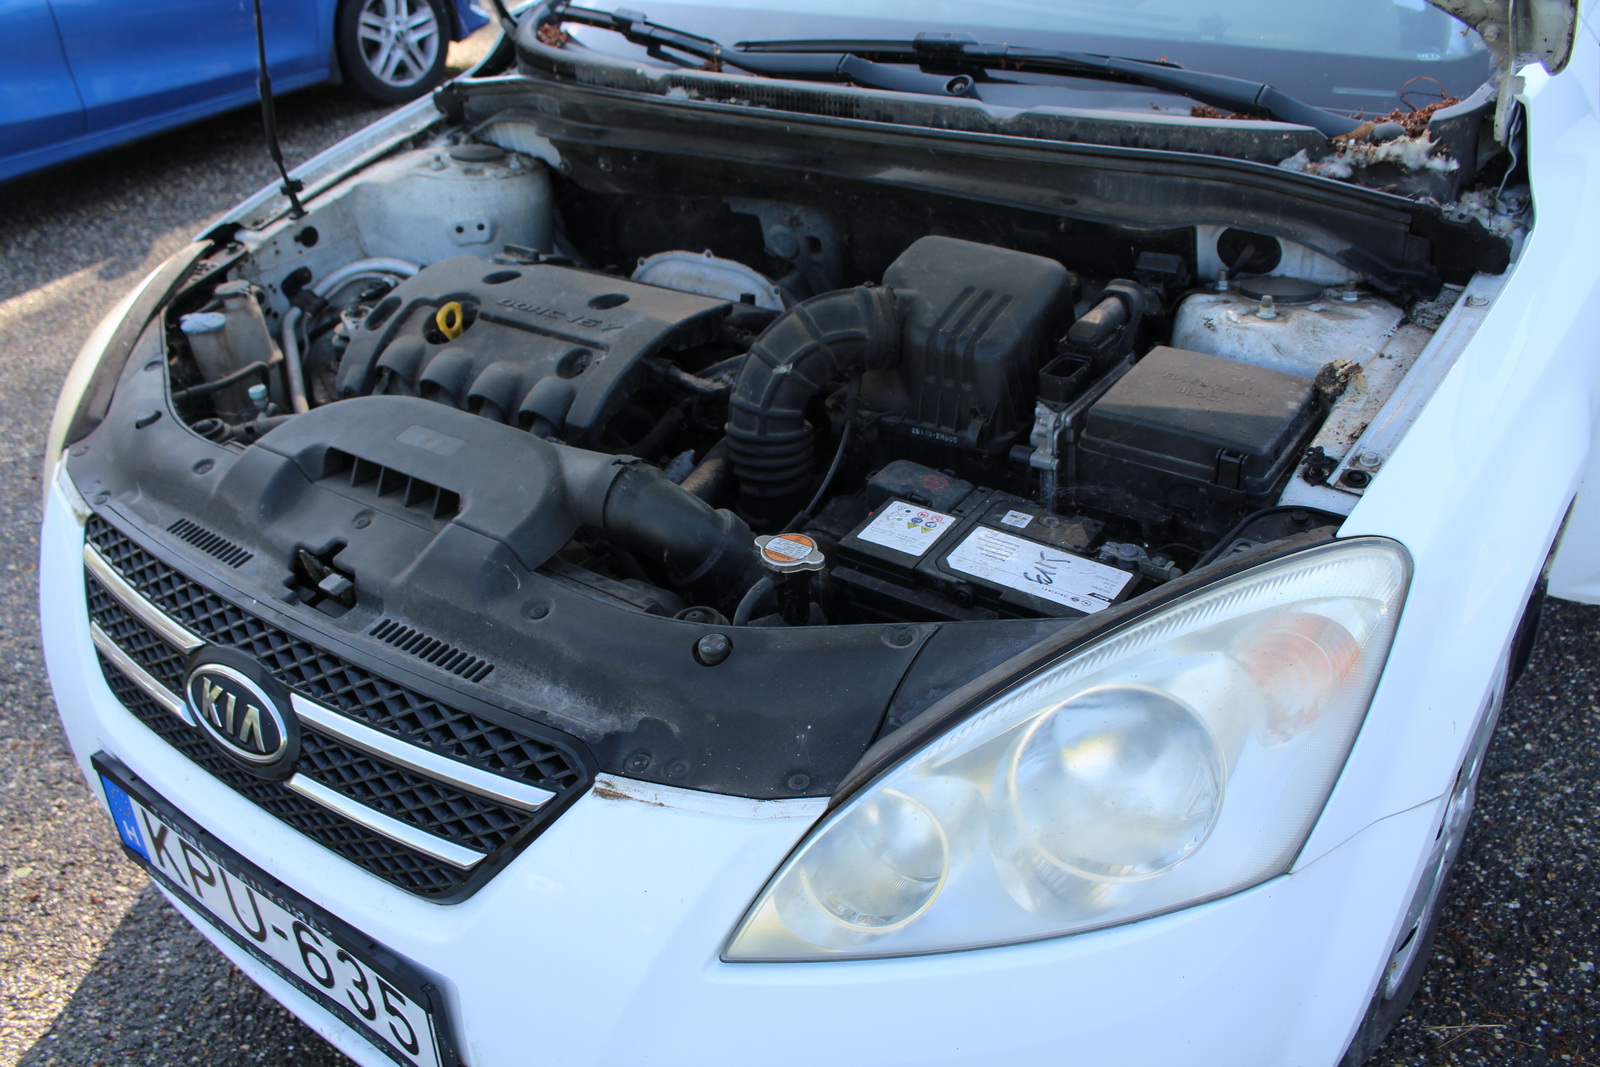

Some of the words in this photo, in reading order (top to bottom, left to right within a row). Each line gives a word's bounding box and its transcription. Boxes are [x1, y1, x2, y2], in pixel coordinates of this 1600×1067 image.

[202, 676, 266, 753] KIA
[122, 819, 141, 847] H
[141, 807, 420, 1056] KPU-635
